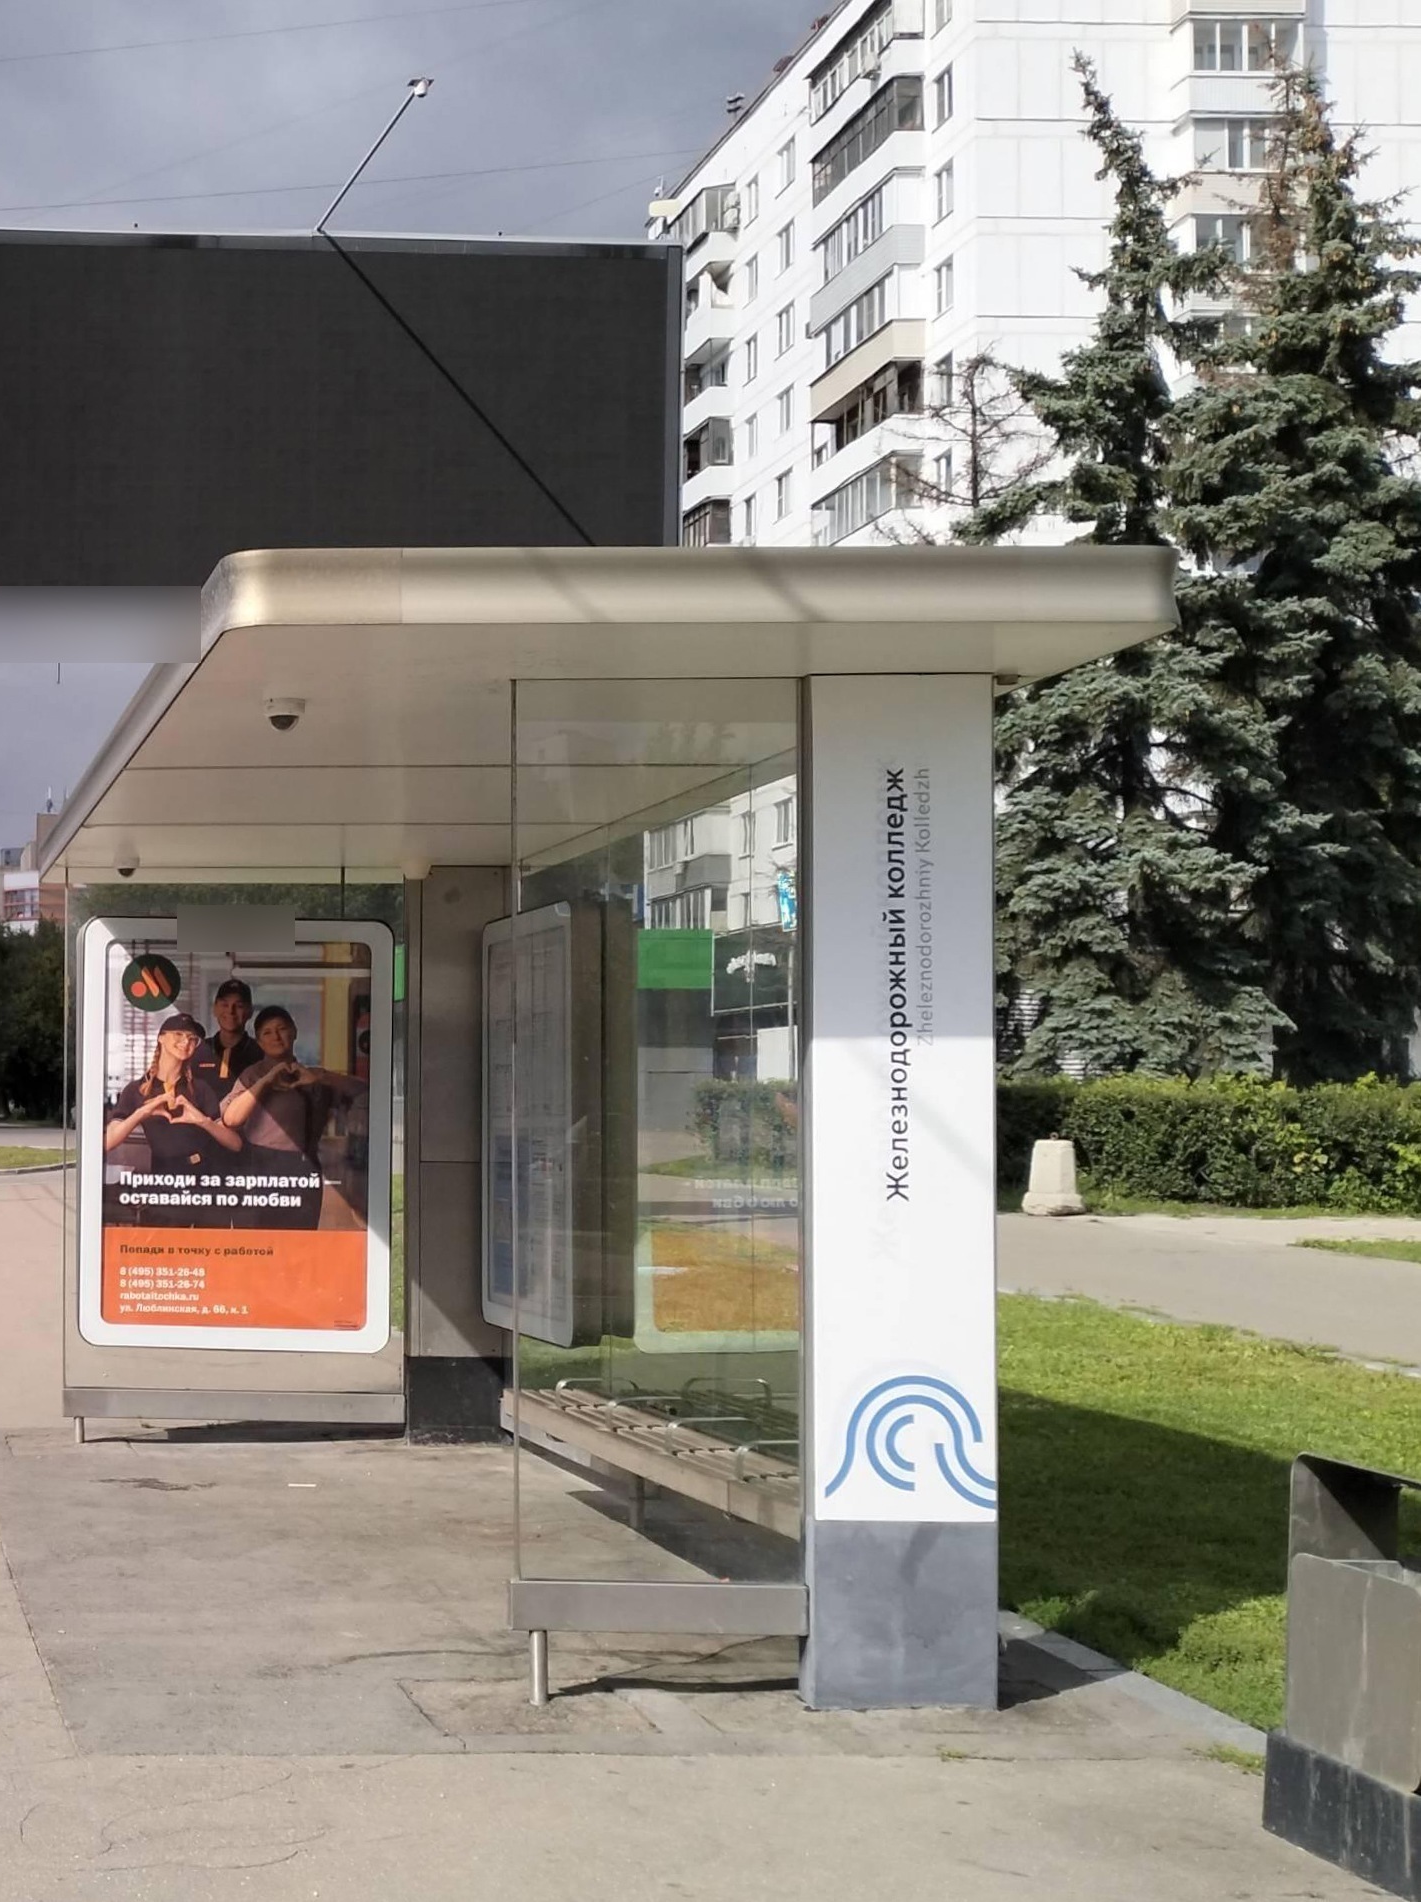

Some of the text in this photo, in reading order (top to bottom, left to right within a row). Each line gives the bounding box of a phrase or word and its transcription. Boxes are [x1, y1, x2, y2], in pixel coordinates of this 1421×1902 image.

[886, 767, 909, 899] колледж
[914, 767, 935, 1046] Zheleznodorozhniy Kolledzh
[882, 908, 913, 1201] Железнодорожный
[119, 1171, 197, 1188] Приходи
[200, 1174, 221, 1187] за
[225, 1173, 320, 1190] зарплатой
[119, 1190, 302, 1207] оставайся по любви
[119, 1244, 274, 1258] Попади в точку с работой
[119, 1266, 127, 1276] 8
[128, 1266, 155, 1277] (495)
[119, 1278, 127, 1288] 8
[128, 1278, 155, 1289] (495)
[119, 1291, 199, 1301] rabotaitochka.ru
[119, 1304, 134, 1314] ул.
[136, 1302, 200, 1314] Люблинская,
[241, 1305, 249, 1315] 1
